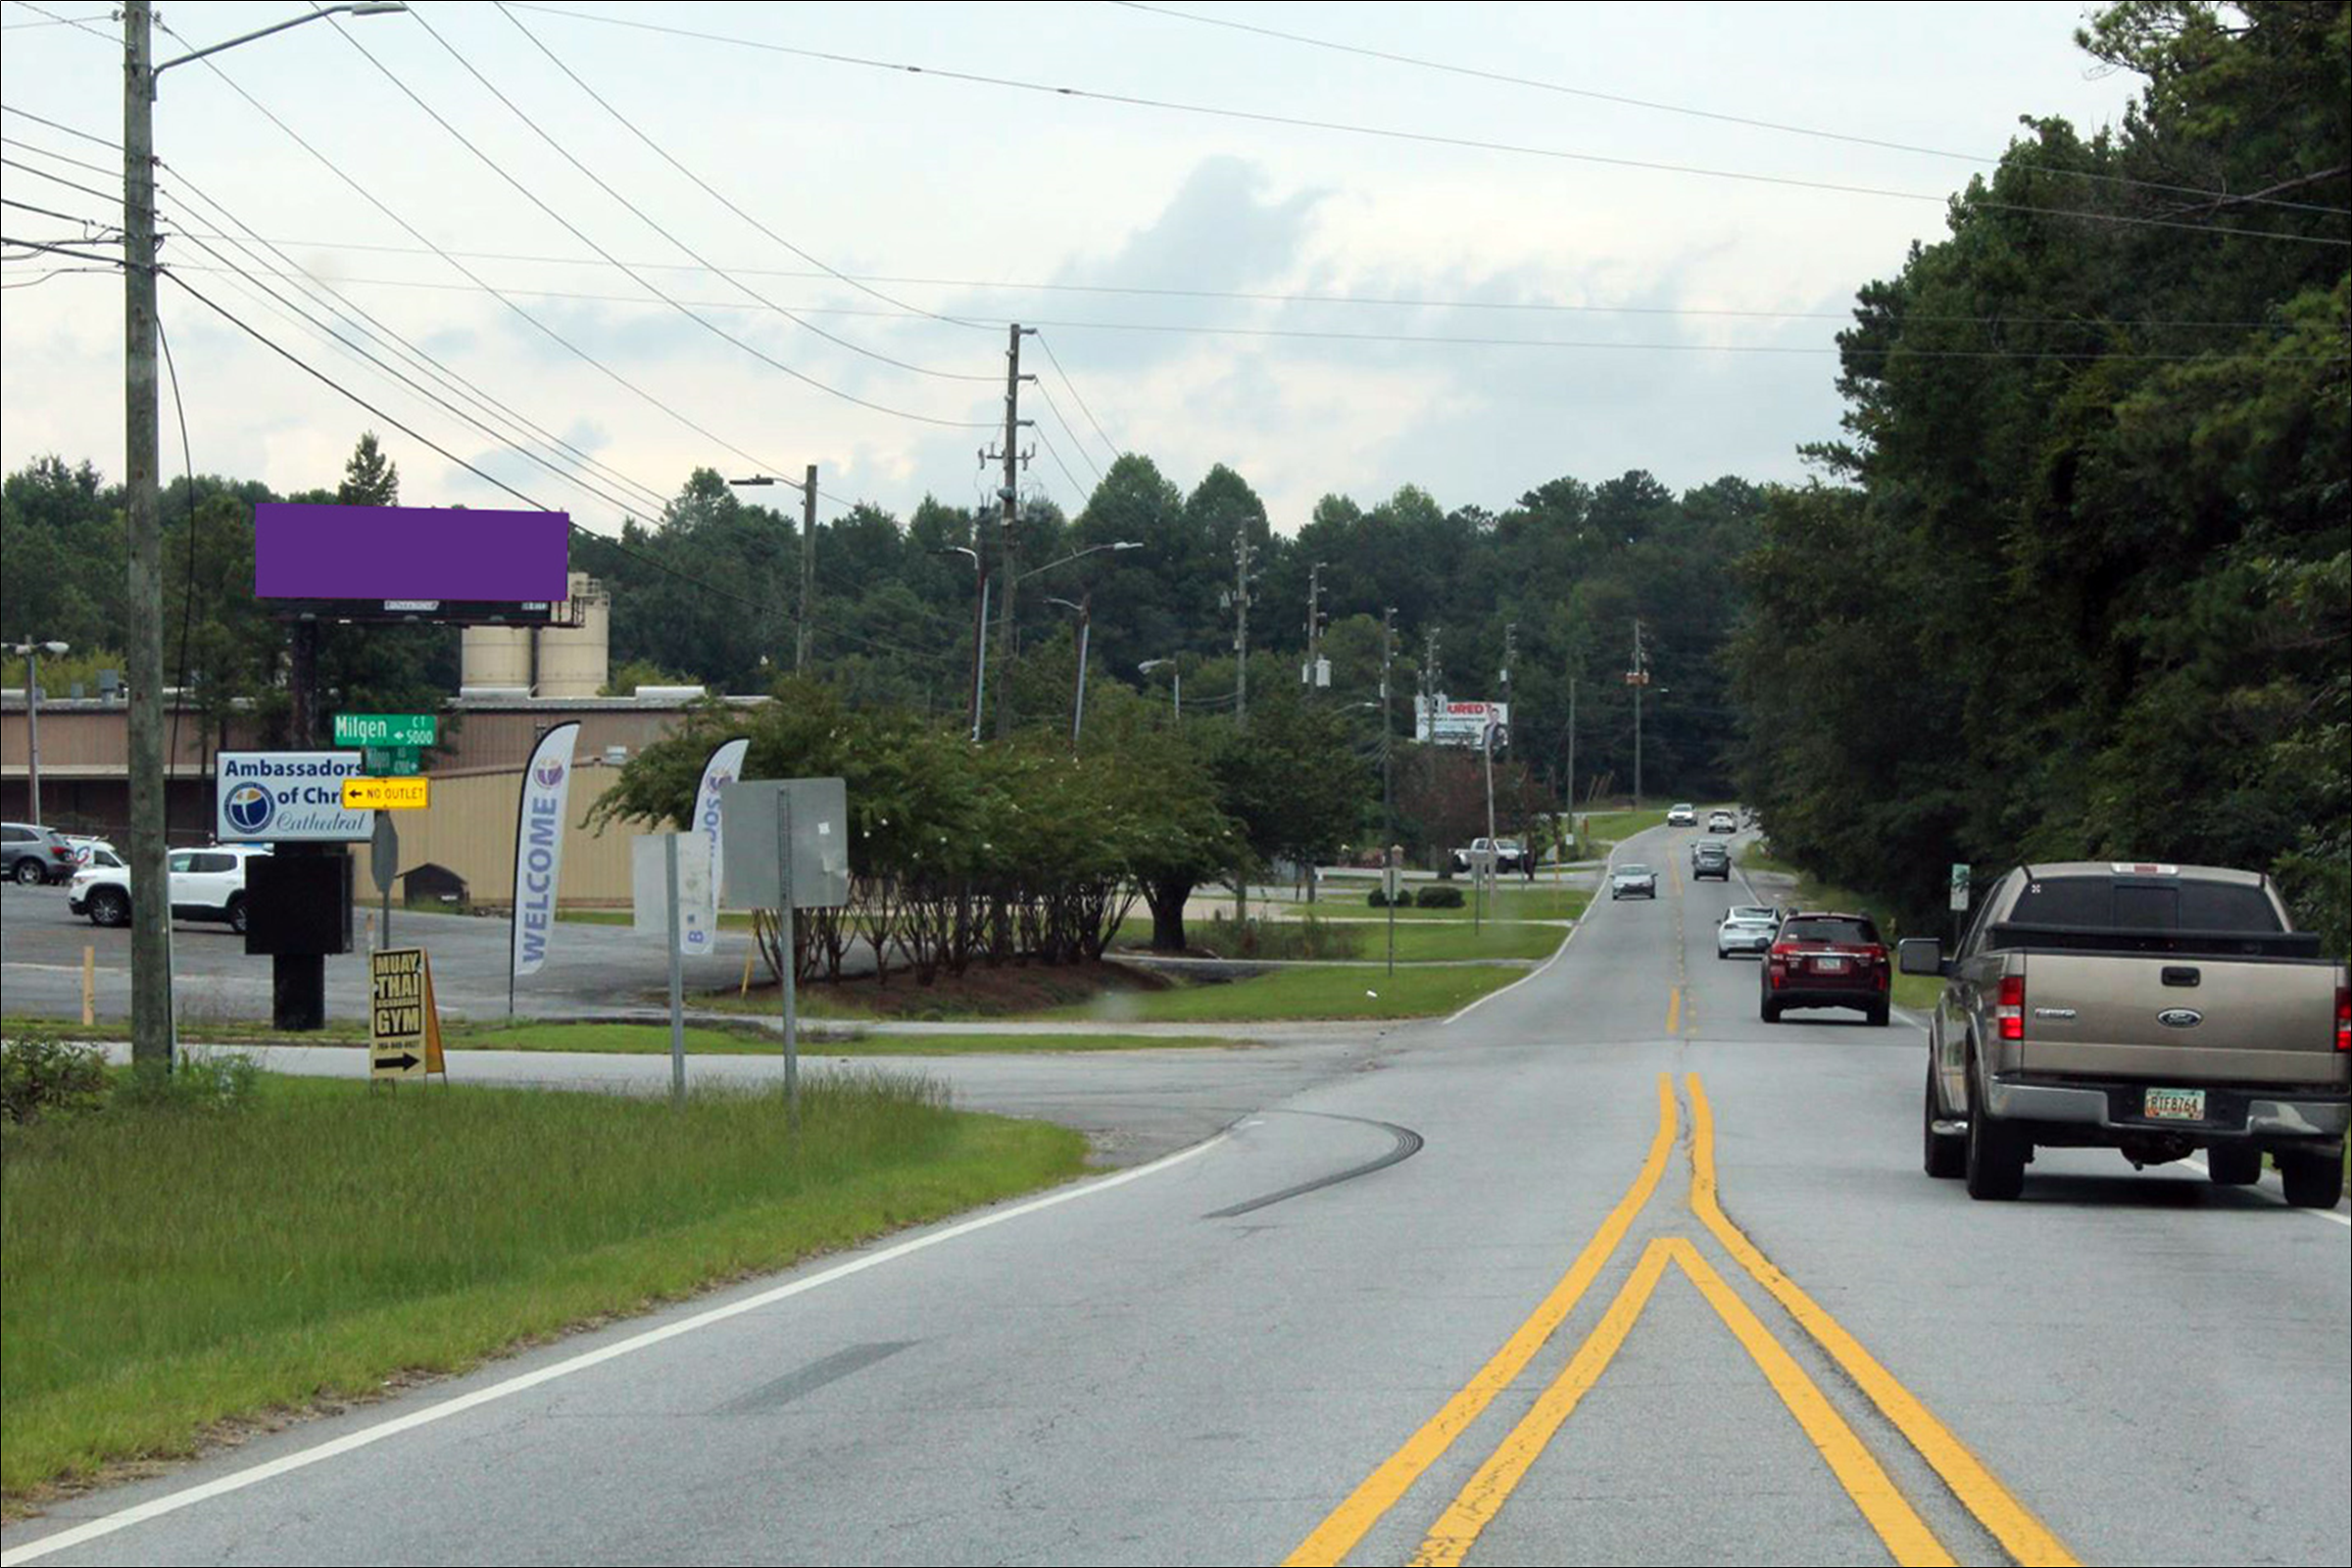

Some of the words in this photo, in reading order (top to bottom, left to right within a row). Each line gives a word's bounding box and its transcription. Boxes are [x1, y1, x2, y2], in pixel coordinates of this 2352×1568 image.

[335, 715, 387, 745] Milgen
[412, 715, 426, 728] CT
[406, 730, 433, 745] 5000
[224, 759, 363, 777] Ambassadors
[277, 787, 299, 805] of
[367, 788, 381, 800] NO
[384, 788, 423, 800] OUTLET
[276, 811, 366, 832] Cathedral
[522, 797, 558, 963] WELCOME
[375, 953, 419, 975] MUAY
[376, 973, 419, 1000] THAI
[376, 1006, 419, 1035] GYM
